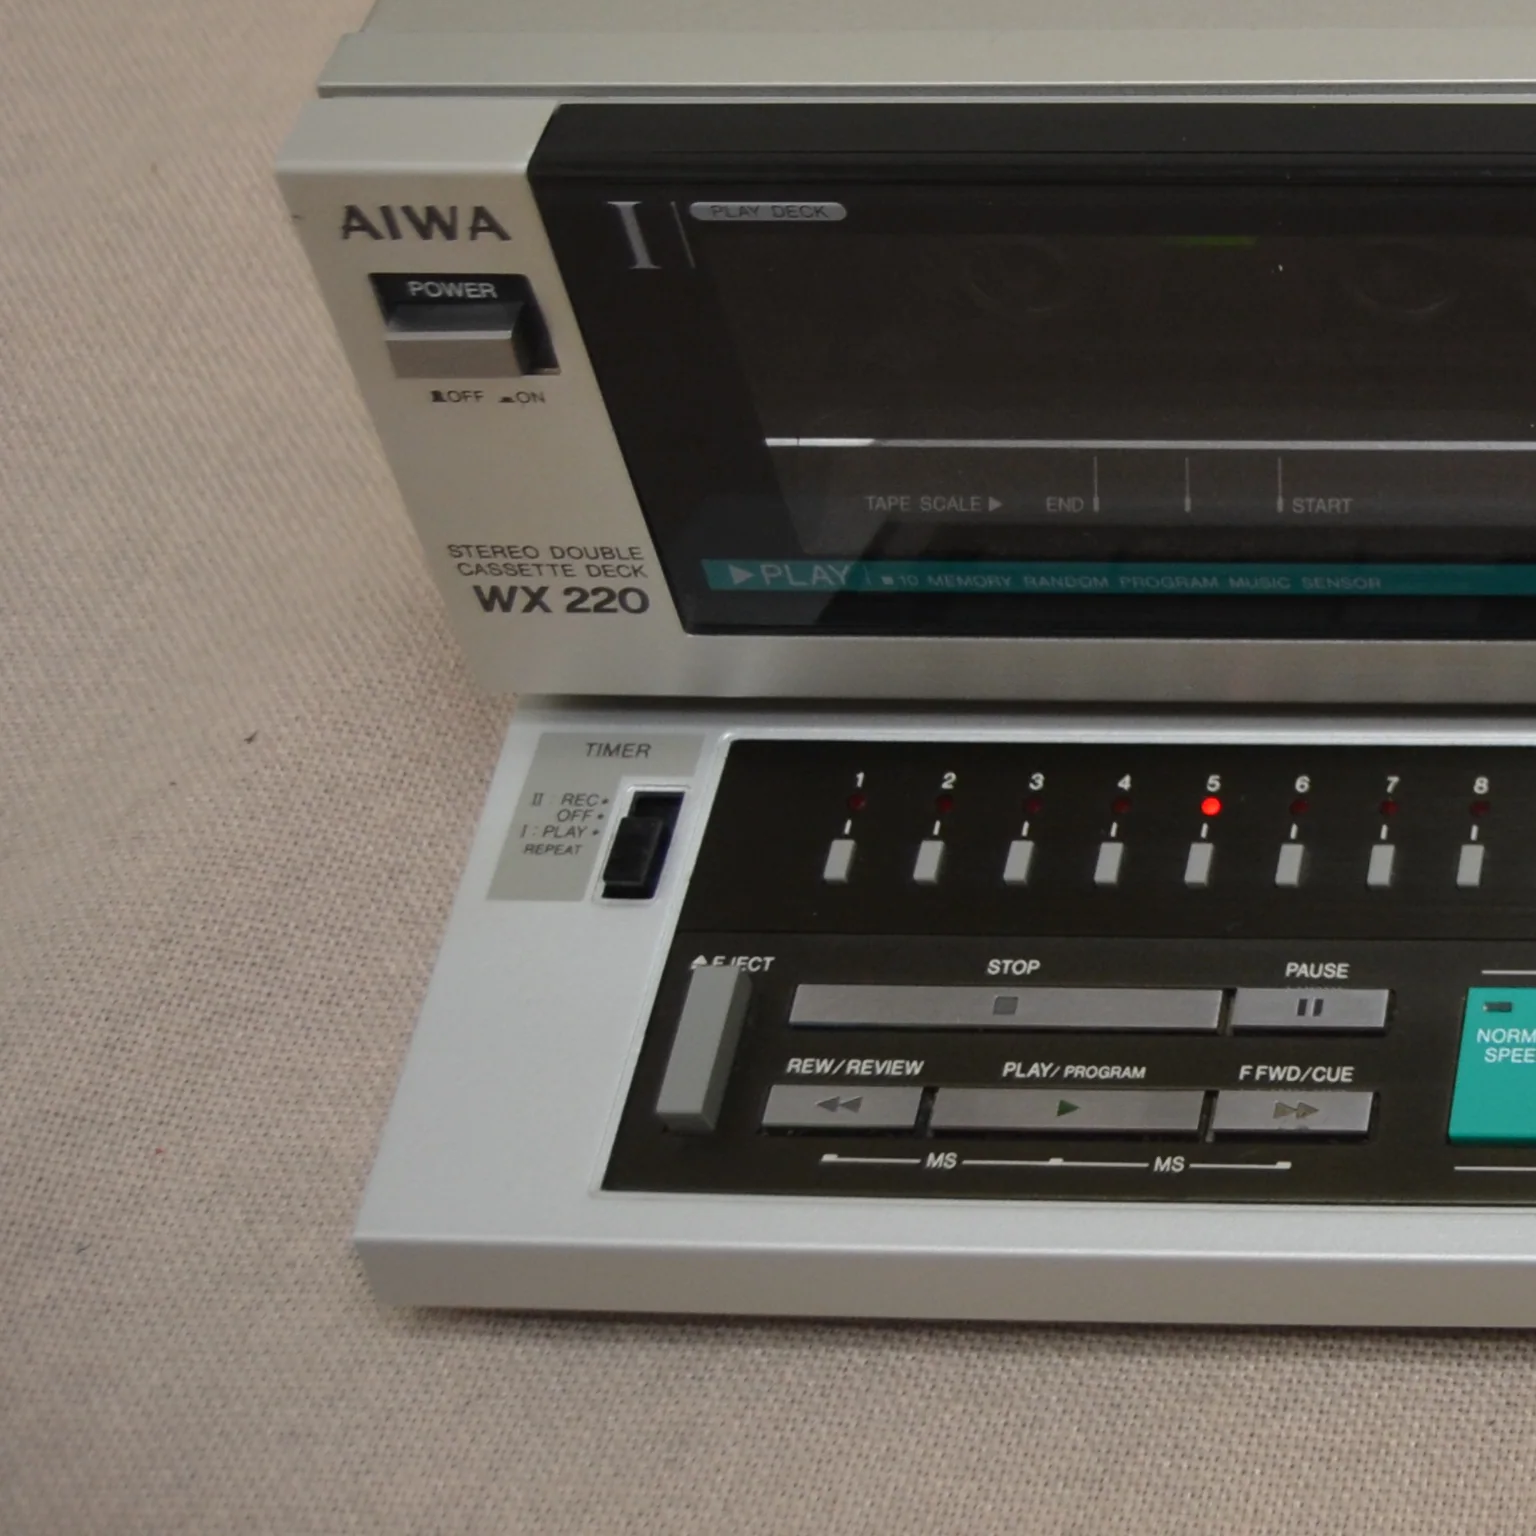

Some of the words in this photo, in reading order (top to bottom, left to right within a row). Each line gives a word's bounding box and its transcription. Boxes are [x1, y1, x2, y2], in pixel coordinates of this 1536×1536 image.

[710, 205, 760, 218] PLAY
[771, 205, 828, 218] DECK
[341, 204, 512, 242] AIWA
[607, 201, 661, 270] I
[408, 280, 498, 300] POWER
[446, 390, 483, 404] OFF
[516, 390, 546, 404] ON
[866, 495, 911, 512] TAPE
[919, 495, 982, 513] SCALE
[1046, 496, 1085, 513] END
[1291, 497, 1352, 514] START
[447, 543, 539, 560] STEREO
[550, 544, 643, 561] DOUBLE
[457, 562, 577, 578] CASSETTE
[585, 562, 647, 578] DECK
[760, 563, 853, 586] PLAY
[927, 573, 1012, 587] MEMORY
[1023, 574, 1109, 588] RANDOM
[1119, 574, 1219, 589] PROGRAM
[1228, 574, 1290, 589] MUSIC
[1301, 576, 1382, 590] SENSOR
[473, 585, 552, 613] WX
[562, 585, 651, 614] 220
[585, 742, 652, 759] TIMER
[855, 772, 865, 789] 1
[942, 772, 957, 789] 2
[1029, 773, 1045, 791] 3
[1117, 774, 1132, 791] 4
[1206, 775, 1221, 792] 5
[1295, 776, 1310, 792] 6
[1385, 777, 1399, 794] 7
[1473, 777, 1489, 795] 8
[560, 793, 600, 808] REC
[556, 809, 593, 822] OFF
[542, 825, 588, 839] PLAY
[523, 843, 583, 856] REPEAT
[986, 958, 1041, 976] STOP
[1285, 962, 1350, 980] PAUSE
[785, 1057, 925, 1078] REW/REVIEW
[1063, 1065, 1147, 1081] PROGRAM
[1256, 1065, 1355, 1084] FWD/CUE
[926, 1151, 958, 1170] MS
[1153, 1155, 1186, 1174] MS
